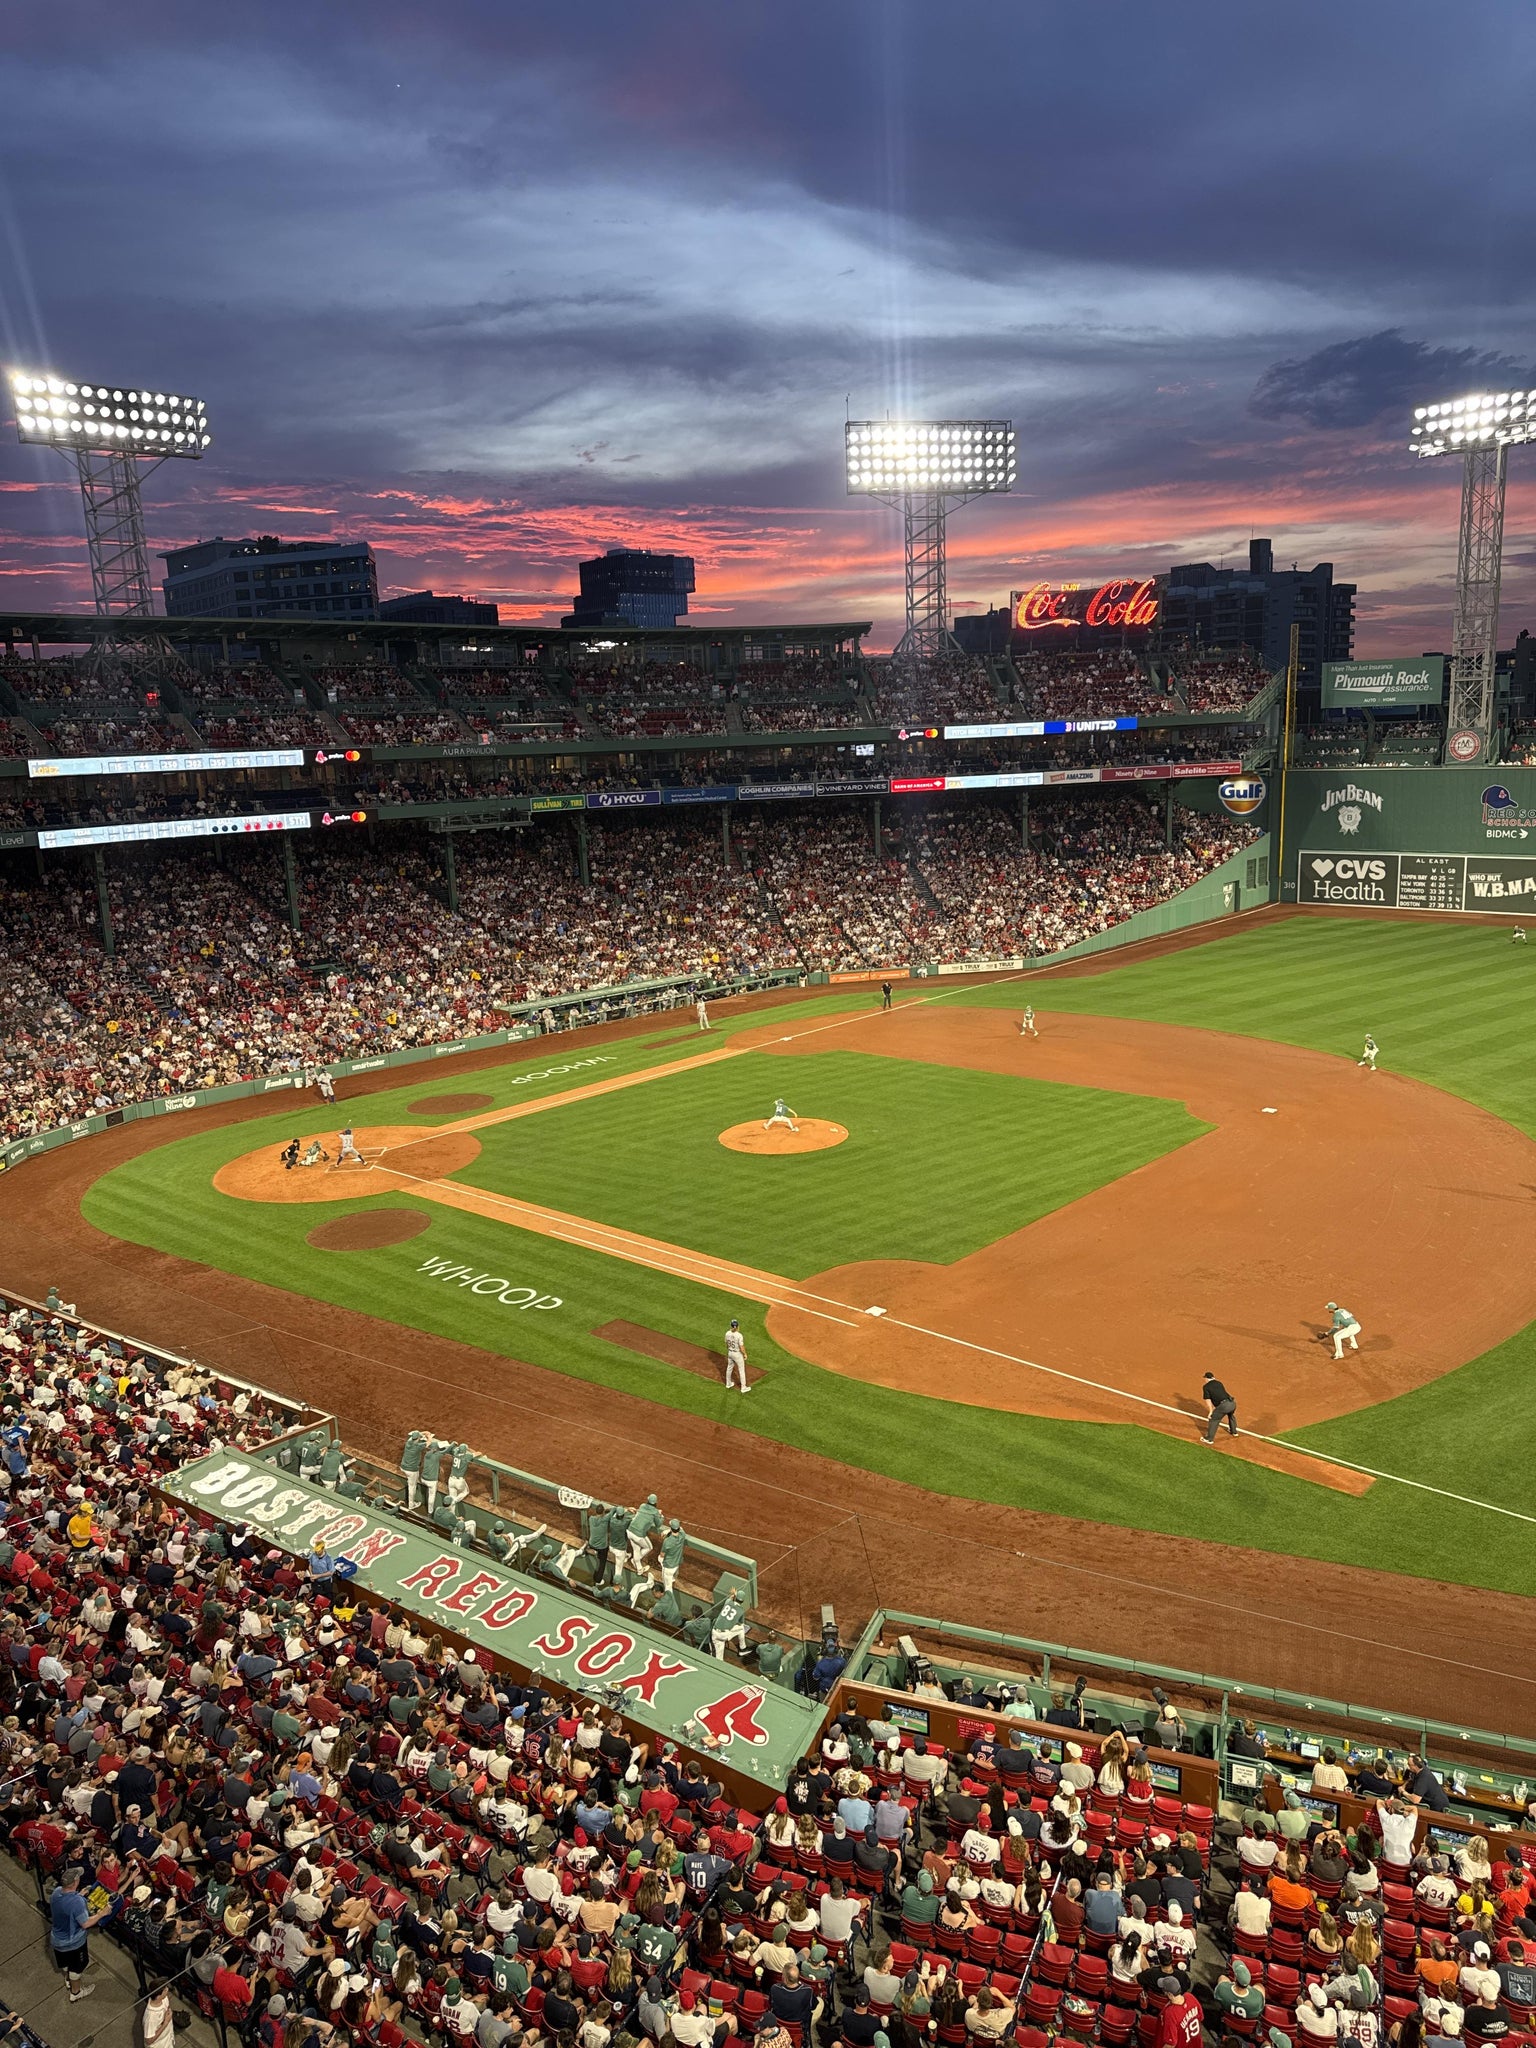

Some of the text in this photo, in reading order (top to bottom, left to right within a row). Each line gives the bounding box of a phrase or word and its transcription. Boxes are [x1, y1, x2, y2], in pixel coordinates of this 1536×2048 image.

[1061, 583, 1081, 592] ENJOY
[1086, 578, 1158, 627] Cola
[1334, 670, 1430, 689] Plymouth Rock
[1385, 685, 1429, 693] assurance
[1076, 720, 1117, 732] UNITED
[466, 747, 496, 755] PAVILION
[1174, 767, 1207, 775] Safelite
[740, 786, 771, 795] COGHLIN
[772, 785, 812, 793] COMPANIES
[825, 784, 863, 792] VINEYARD
[1221, 783, 1262, 799] Gulf
[533, 799, 583, 809] SULLIVAN TIRE
[614, 794, 645, 804] HYCU
[1321, 784, 1382, 812] JIM BEAM
[1488, 809, 1515, 818] RED
[1486, 829, 1517, 838] BIDMC
[0, 834, 24, 846] Level
[1335, 859, 1386, 880] CVS
[1487, 874, 1501, 882] BUT
[1284, 881, 1296, 889] 310
[1313, 880, 1385, 902] Health
[352, 1059, 385, 1071] smartwater
[512, 1056, 617, 1084] WHOOP
[264, 1078, 292, 1090] Franklin
[165, 1095, 183, 1106] Ninety
[166, 1102, 183, 1111] Nine
[416, 1256, 563, 1310] WHOOP
[453, 1457, 461, 1469] 91
[190, 1461, 698, 1710] BOSTON RED SOX
[720, 1604, 737, 1621] 83
[958, 1719, 984, 1728] CAUTION
[970, 1846, 987, 1862] 53
[691, 1861, 703, 1869] MAYE
[691, 1870, 707, 1889] 10
[1429, 1888, 1445, 1902] 34
[207, 1891, 220, 1914] 34
[270, 1938, 286, 1962] 34
[643, 1939, 662, 1960] 34
[495, 1970, 507, 1992] 19
[1230, 2004, 1247, 2018] 19
[1180, 2006, 1199, 2029] UEHARA
[1184, 2018, 1200, 2043] 19
